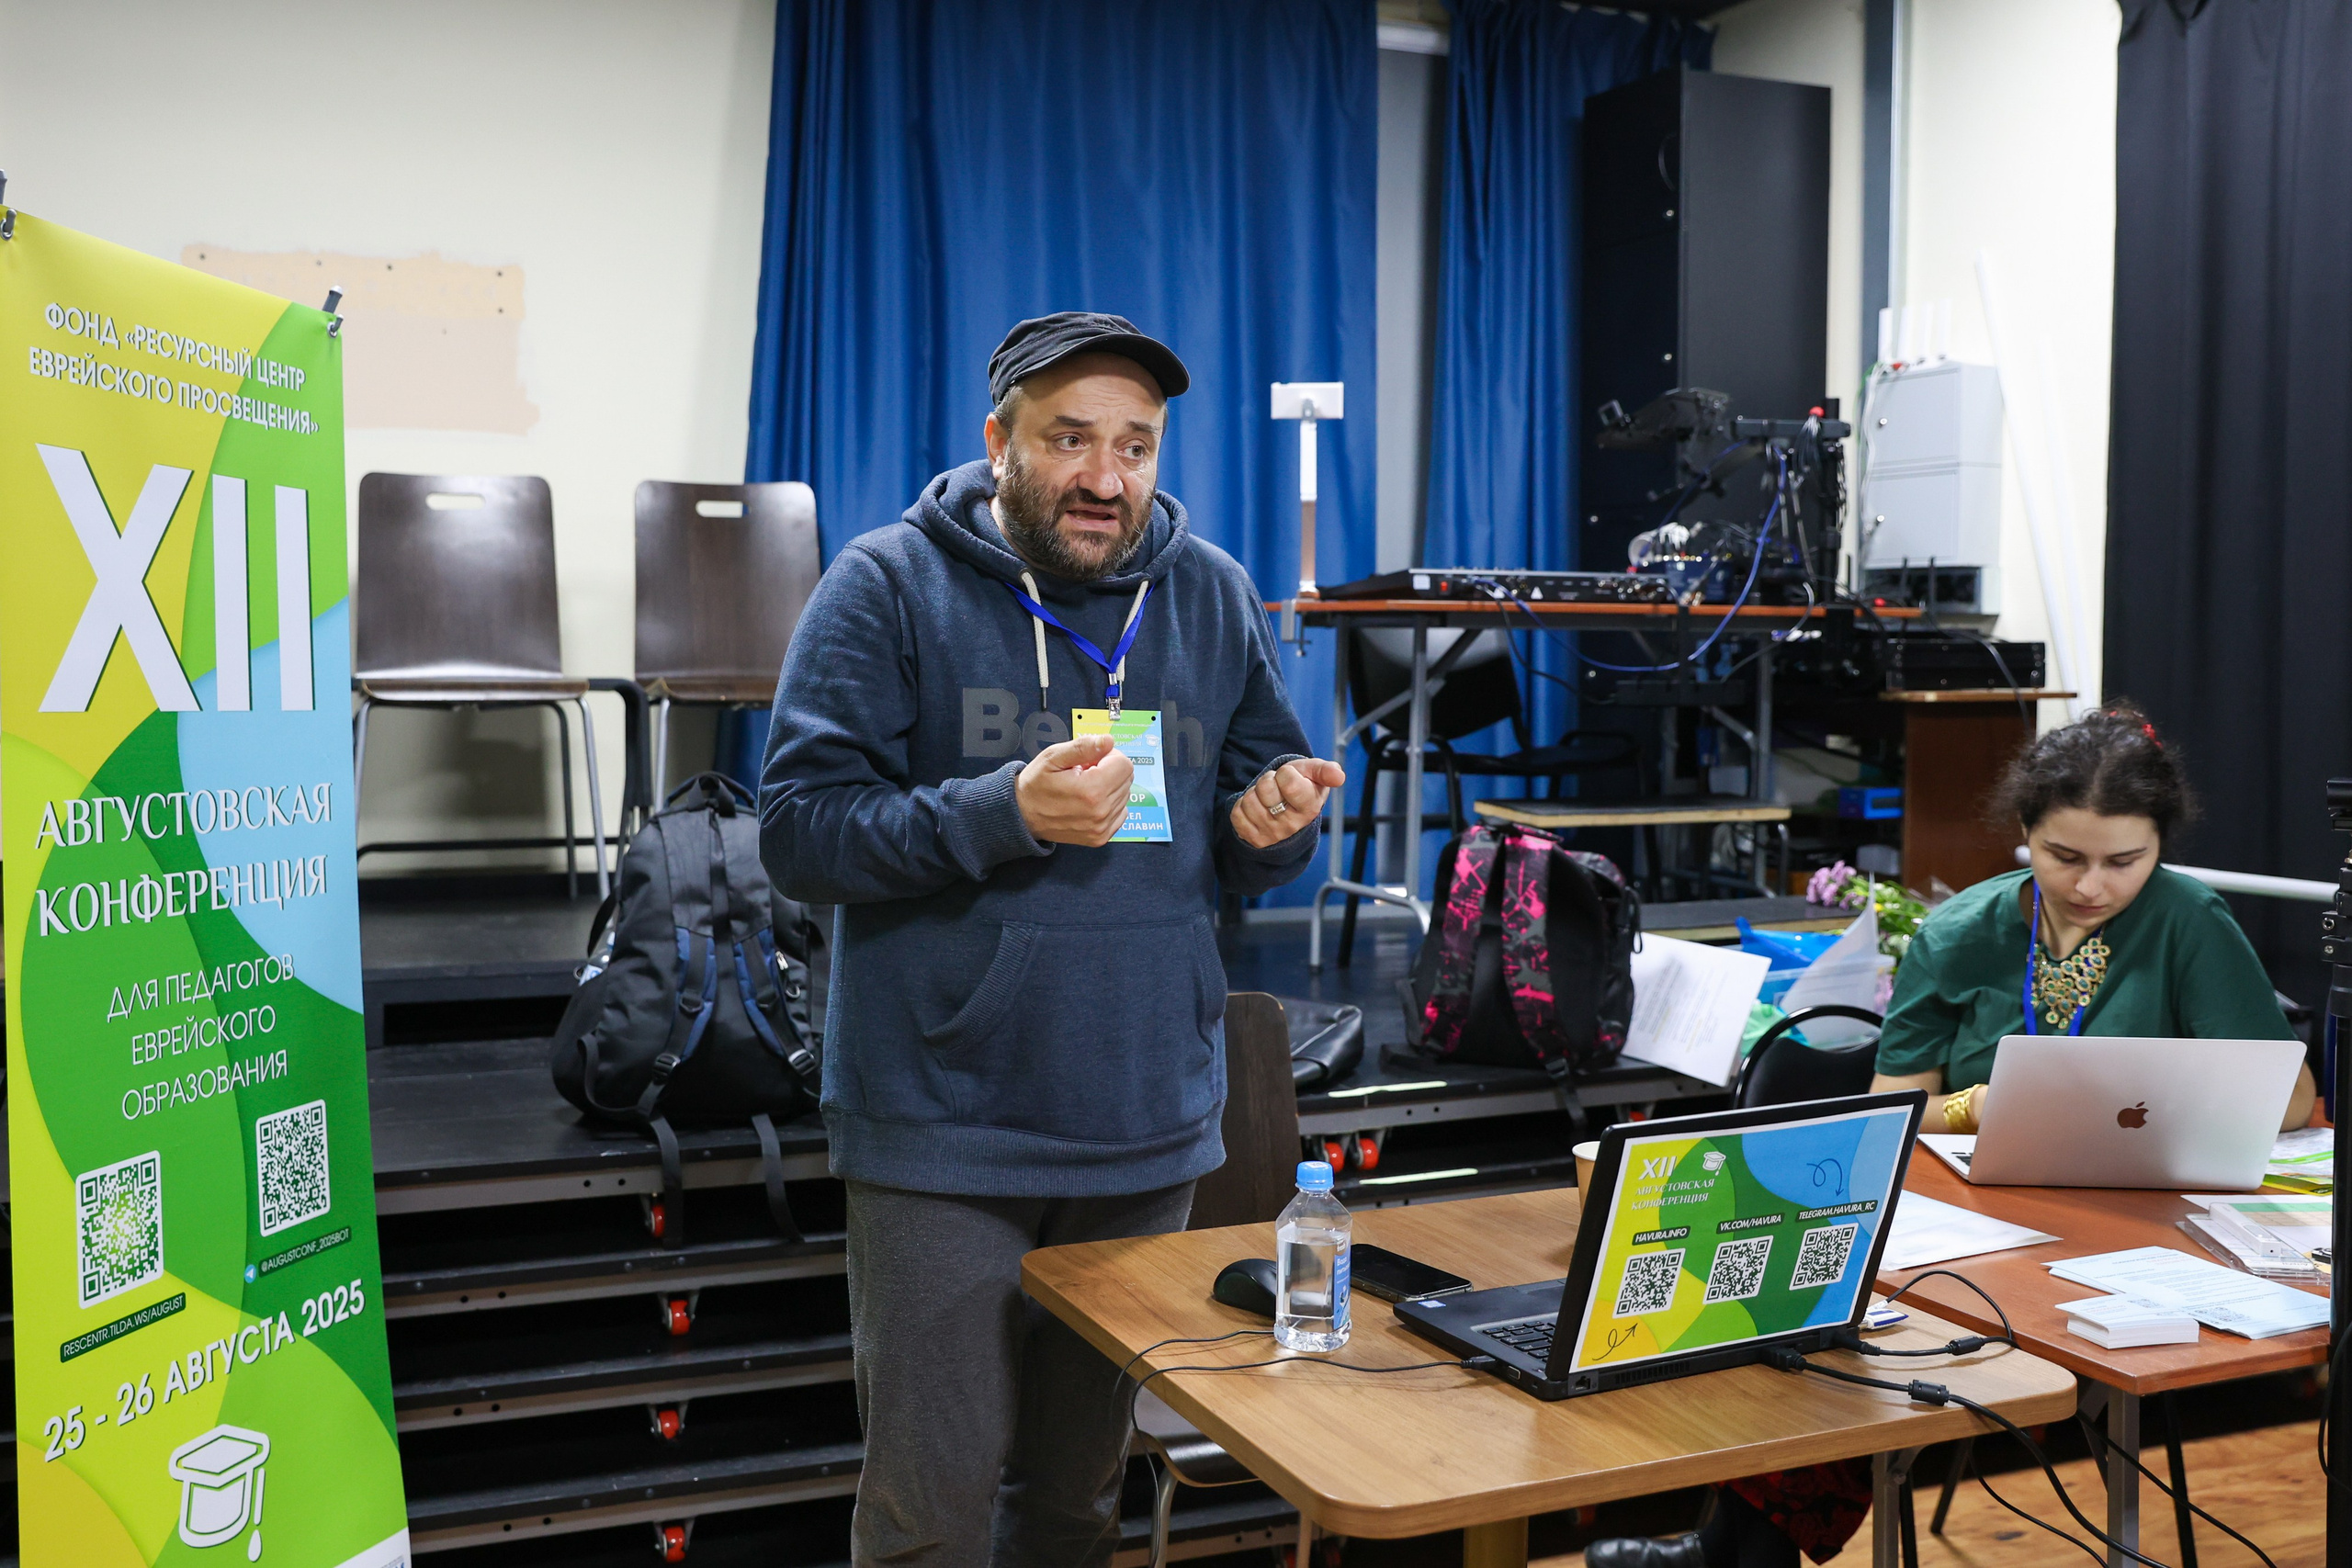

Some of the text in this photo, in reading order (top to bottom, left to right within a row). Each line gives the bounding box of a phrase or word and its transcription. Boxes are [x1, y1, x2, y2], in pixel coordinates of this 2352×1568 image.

[45, 302, 306, 391] ФОНД «РЕСУРСНЫЙ ЦЕНТР
[29, 346, 319, 435] ЕВРЕЙСКОГО ПРОСВЕЩЕНИЯ»
[35, 442, 316, 713] XII
[963, 688, 1204, 767] Beh
[35, 783, 332, 849] АВГУСТОВСКАЯ
[1122, 822, 1163, 830] СЛАВИН
[36, 854, 328, 937] КОНФЕРЕНЦИЯ
[107, 953, 295, 1022] ДЛЯ ПЕДАГОГОВ
[132, 1005, 277, 1066] ЕВРЕЙСКОГО
[122, 1050, 288, 1121] ОБРАЗОВАНИЯ
[1635, 1179, 1714, 1196] АВГУСТОВСКАЯ
[1638, 1156, 1677, 1180] XII
[1632, 1193, 1709, 1211] КОНФЕРЕНЦИЯ
[1720, 1214, 1781, 1231] VK.COM/HAVURA
[261, 1228, 349, 1272] @AUGUSTCONF_2025BOT
[1635, 1228, 1688, 1243] HAVURA.INFO
[63, 1295, 183, 1357] RESCENTR.TILDA.WS/AUGUST
[43, 1406, 86, 1462] 25
[117, 1373, 154, 1426] 26
[164, 1310, 296, 1404] АВГУСТА
[301, 1279, 366, 1337] 2025
